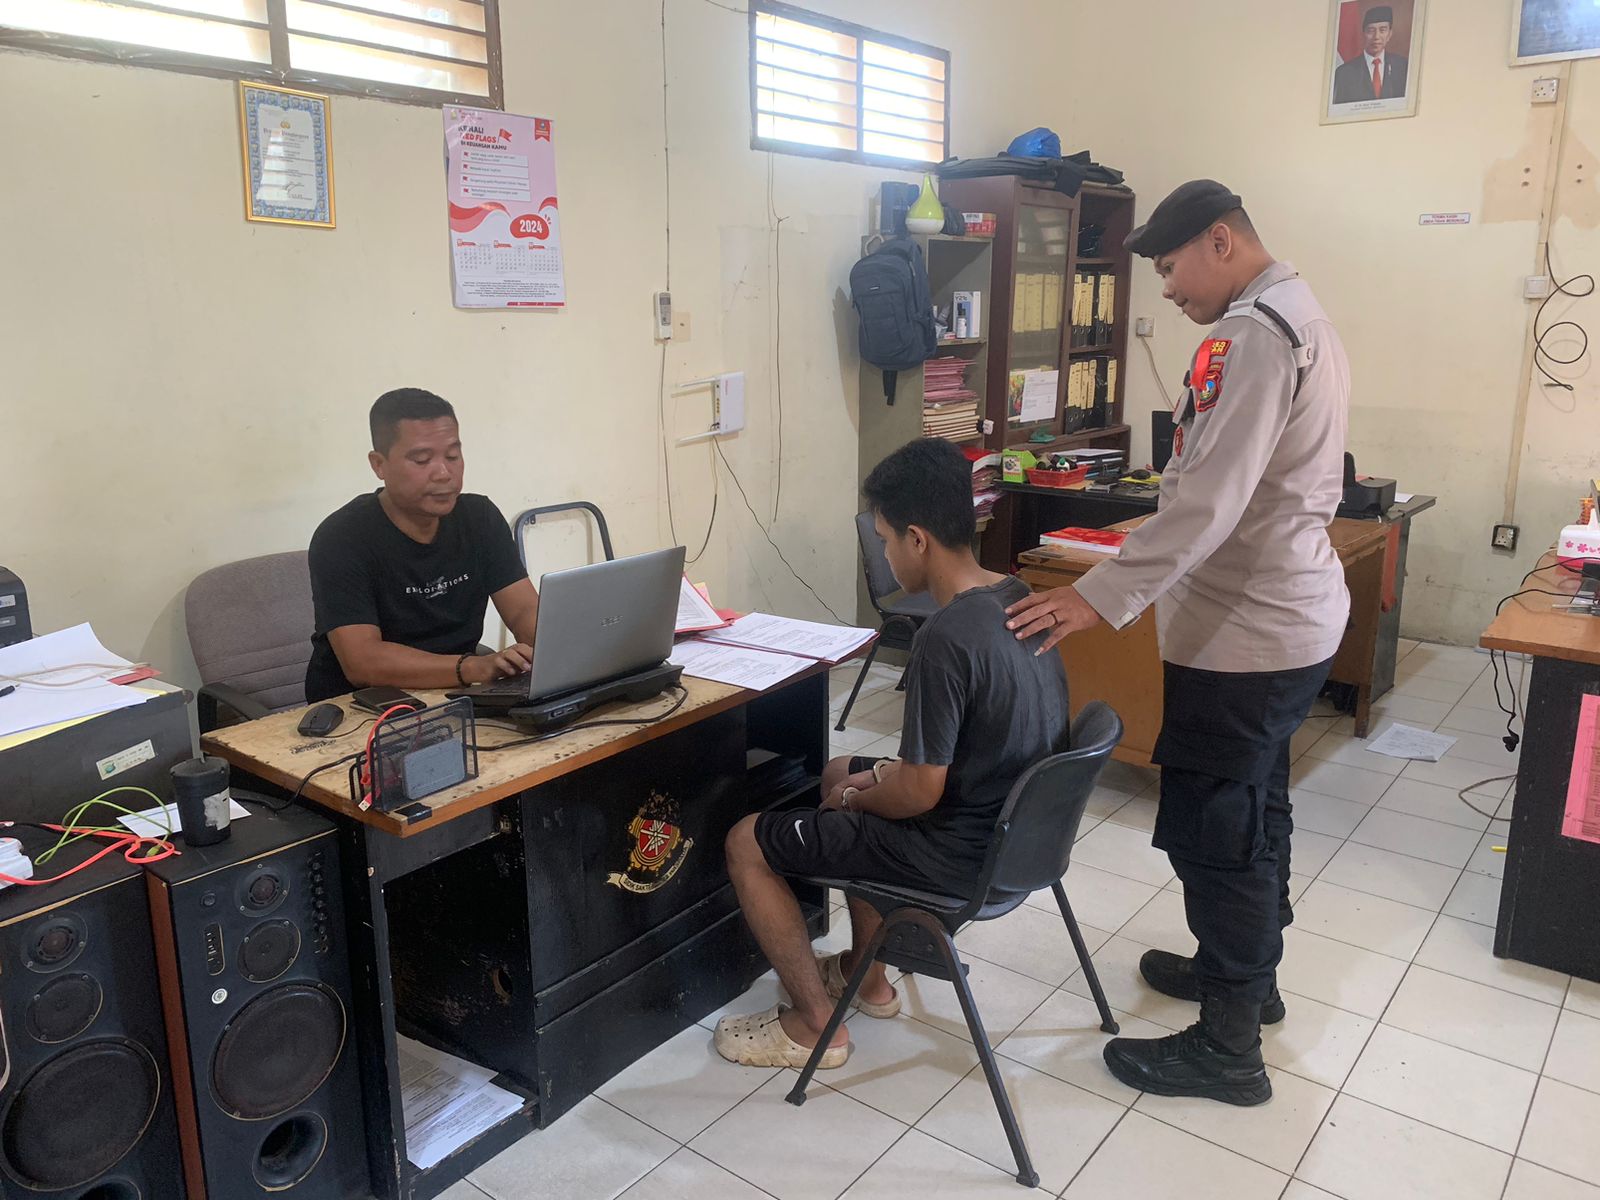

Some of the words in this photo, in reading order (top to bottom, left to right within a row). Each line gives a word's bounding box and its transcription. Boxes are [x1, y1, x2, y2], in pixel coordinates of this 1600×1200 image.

[460, 133, 475, 141] ED
[475, 134, 497, 143] FLAGS
[520, 219, 543, 233] 2024
